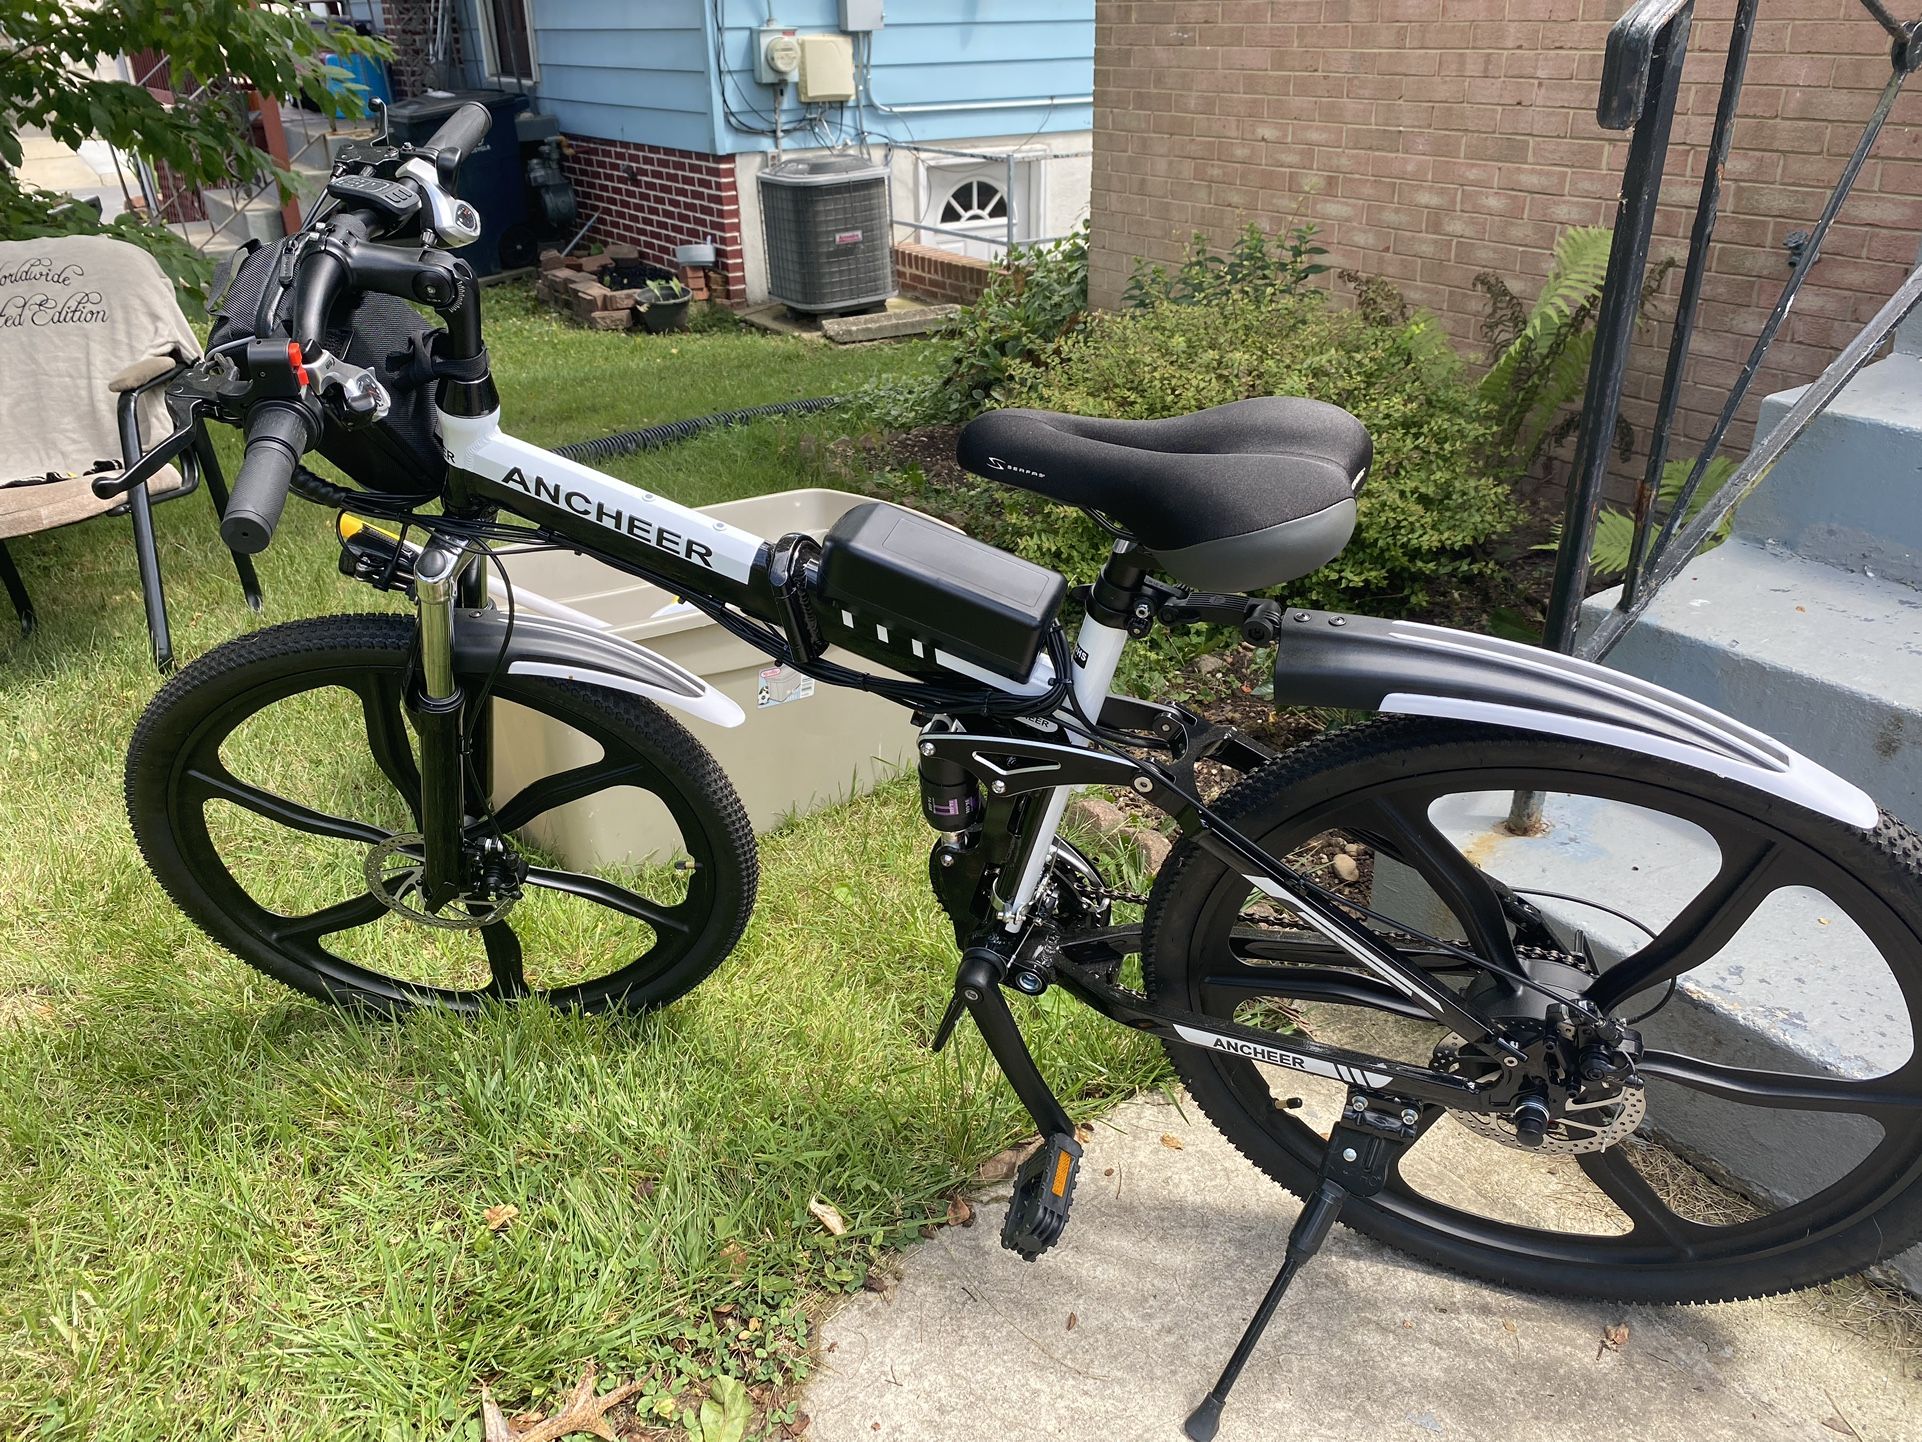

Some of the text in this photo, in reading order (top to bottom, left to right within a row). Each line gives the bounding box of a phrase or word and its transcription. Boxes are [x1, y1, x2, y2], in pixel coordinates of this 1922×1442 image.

[0, 257, 84, 287] orldwide
[29, 291, 109, 327] Edition
[501, 466, 714, 568] ANCHEER
[1213, 1037, 1305, 1069] ANCHEER
